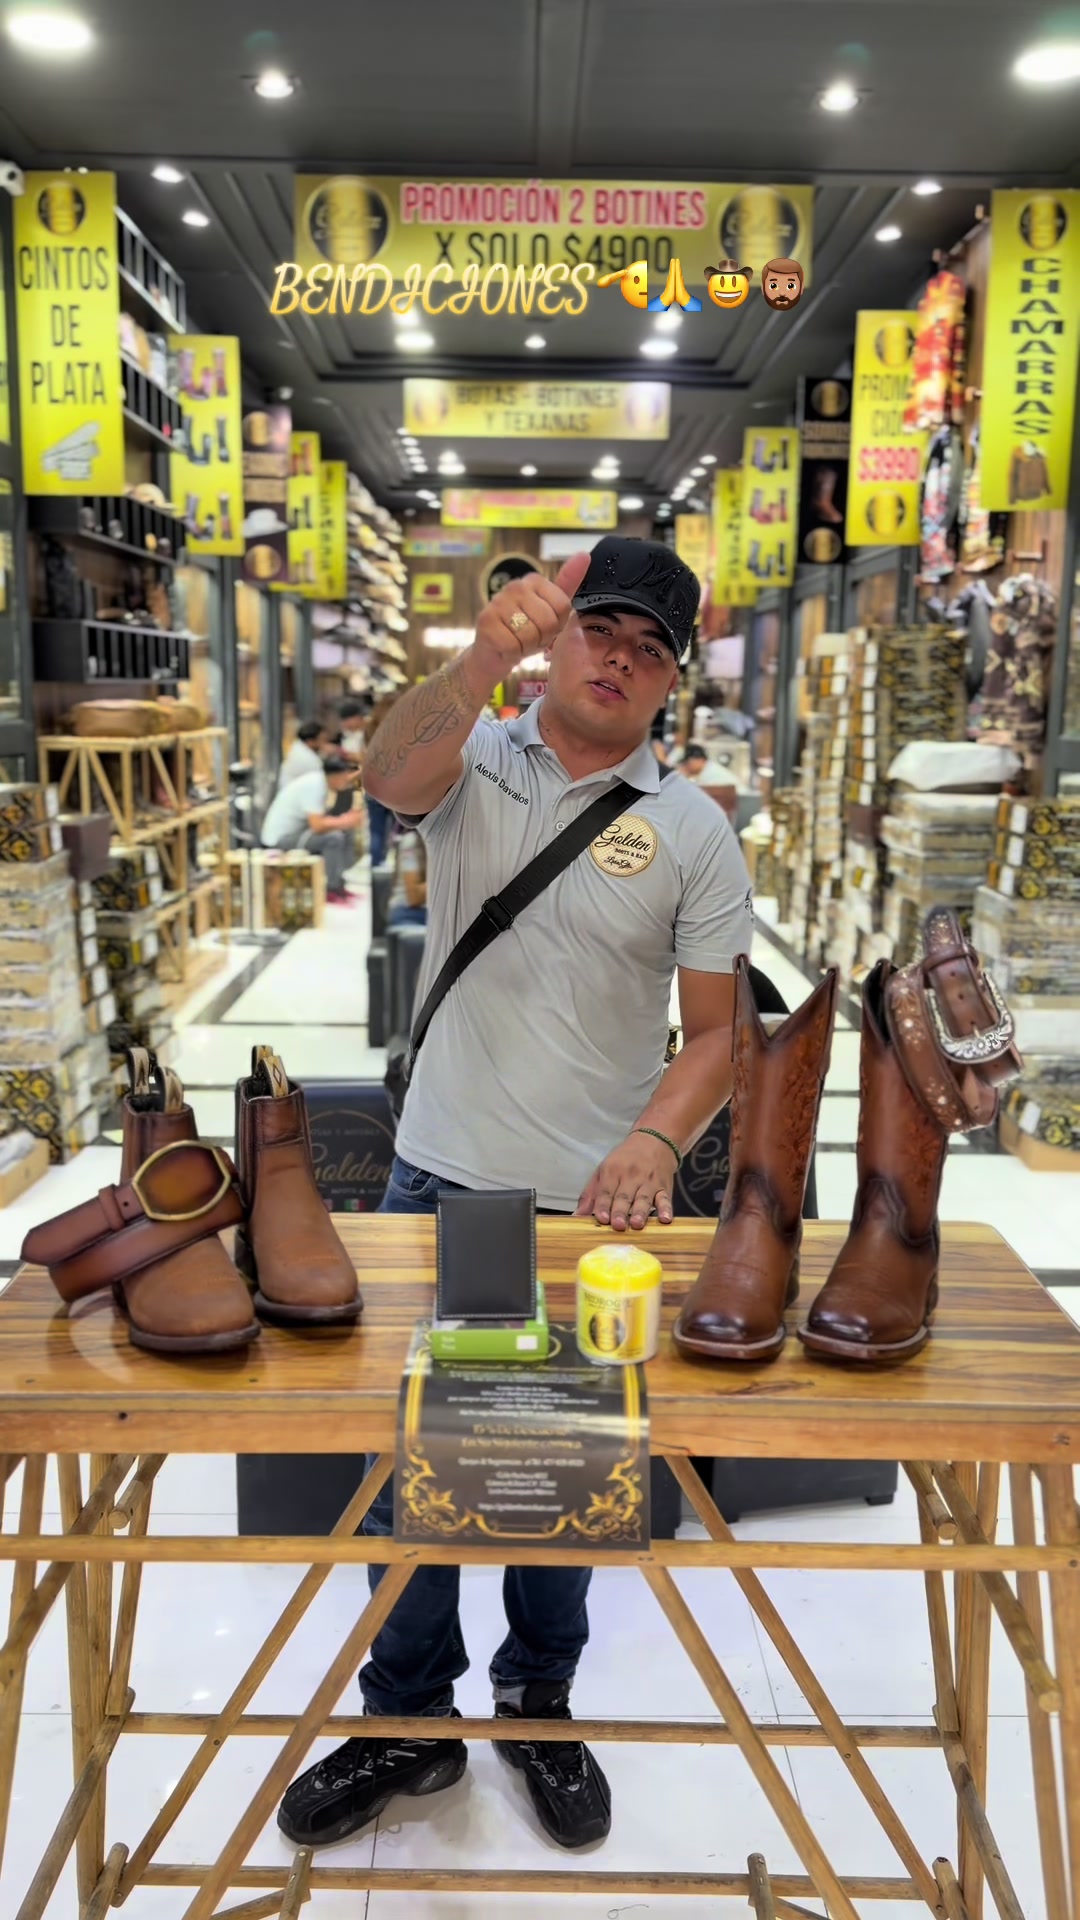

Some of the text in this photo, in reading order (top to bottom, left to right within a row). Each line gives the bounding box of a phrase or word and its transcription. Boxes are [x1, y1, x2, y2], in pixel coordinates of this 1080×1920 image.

[402, 179, 560, 224] PROMOCIÓN
[569, 187, 585, 225] 2
[594, 188, 706, 229] BOTINES
[18, 246, 110, 291] CINTOS
[434, 231, 674, 274] X SOLO $4900
[50, 305, 82, 348] DE
[1010, 257, 1065, 435] CHAMARRAS
[31, 361, 108, 404] PLATA
[456, 386, 516, 406] BOTAS
[537, 387, 618, 408] BOTINES
[474, 762, 530, 806] Alexis Davalos
[594, 824, 651, 852] Golden
